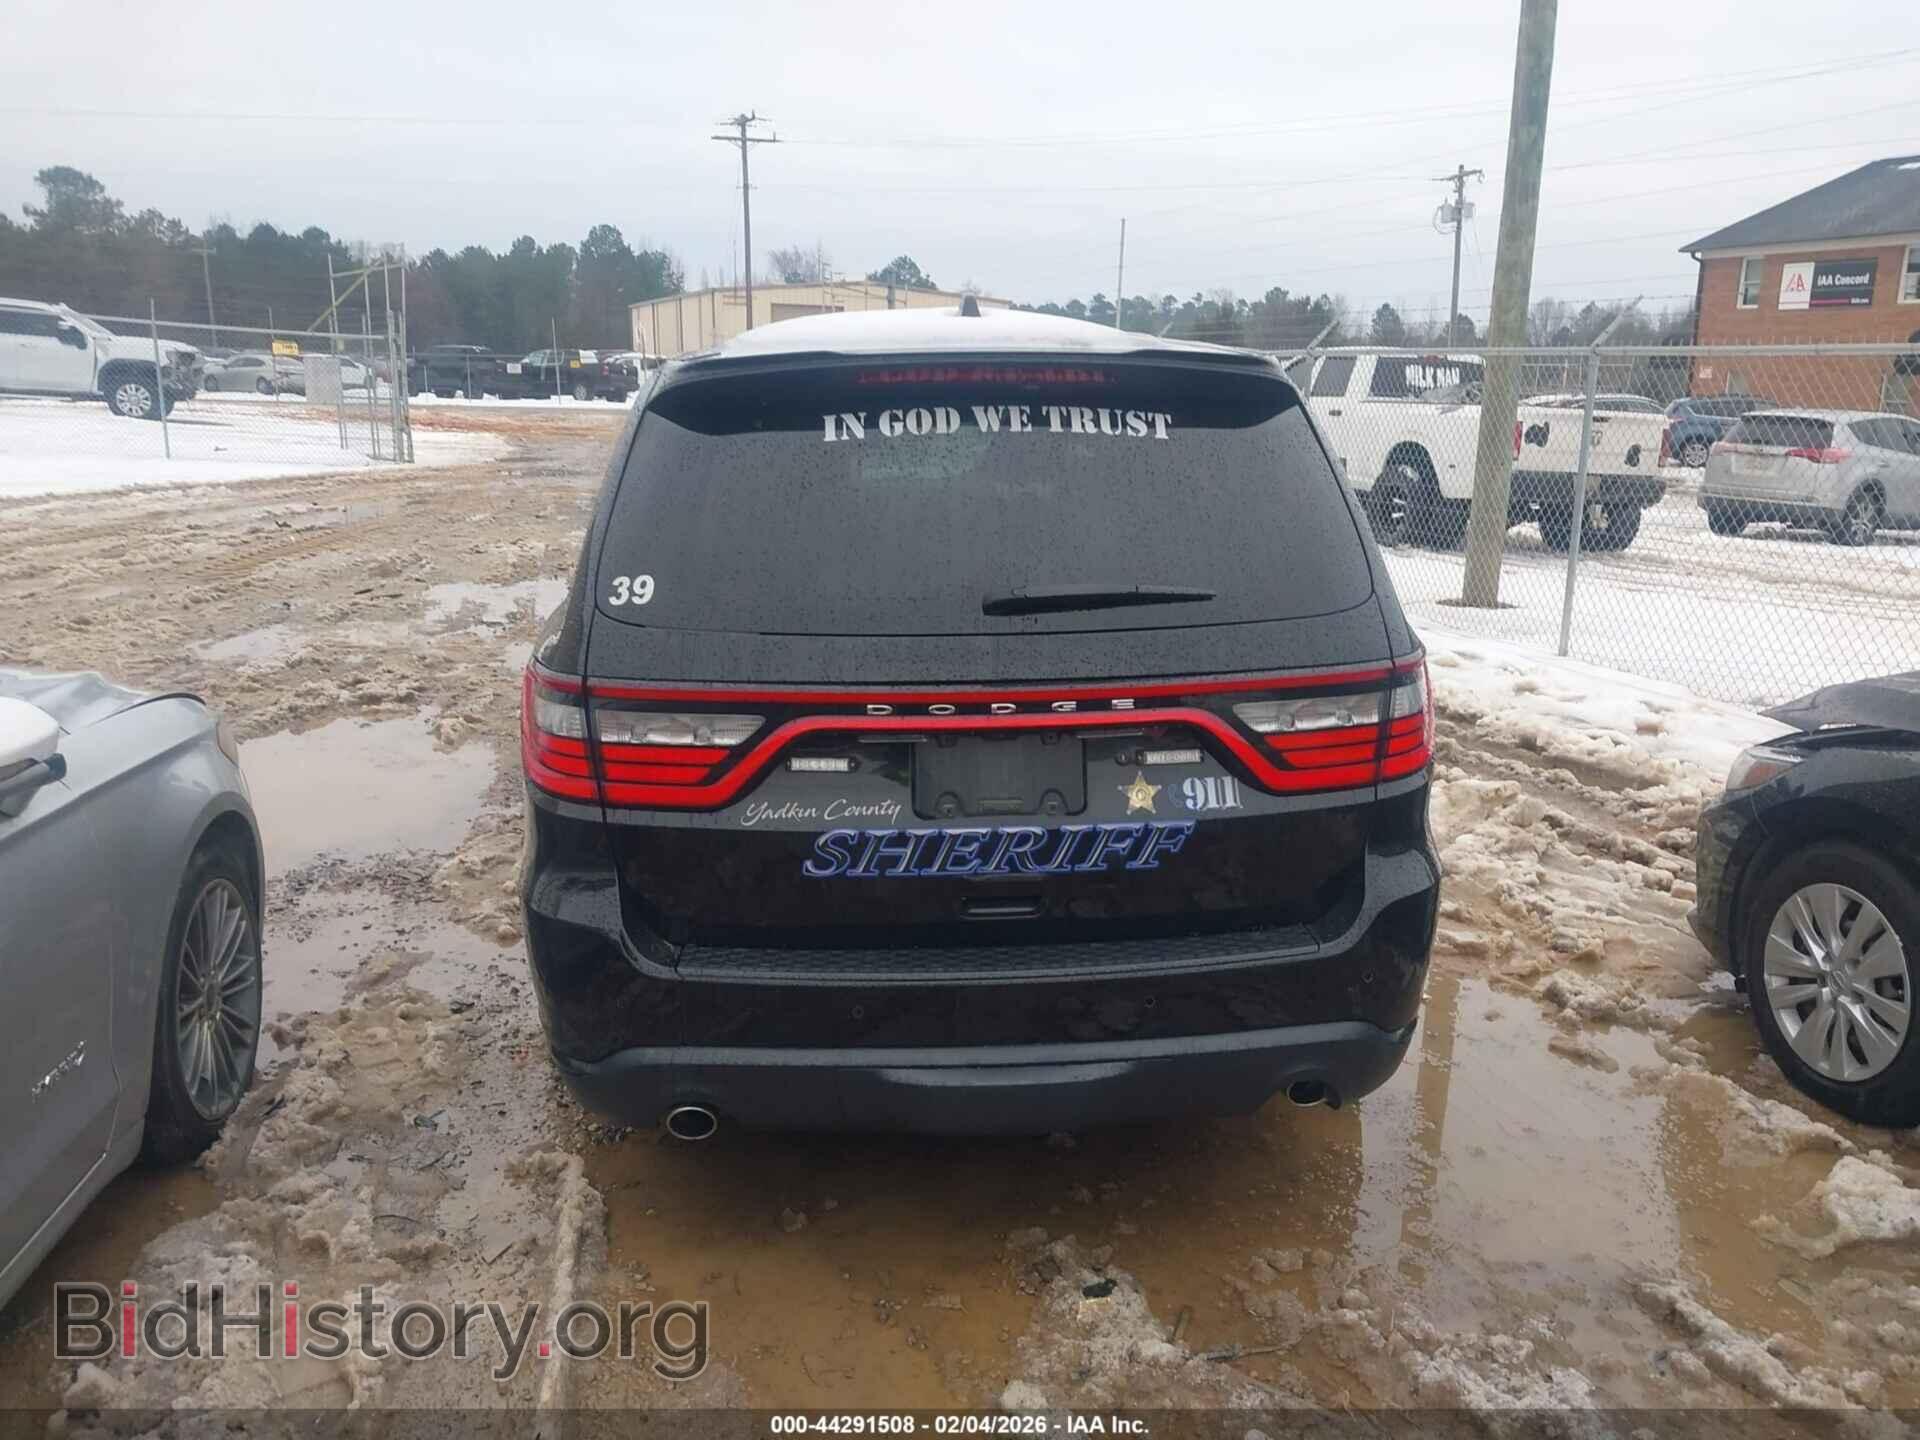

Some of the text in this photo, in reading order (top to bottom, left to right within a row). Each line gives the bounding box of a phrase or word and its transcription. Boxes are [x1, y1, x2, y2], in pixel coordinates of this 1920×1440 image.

[1817, 272, 1870, 286] IAA Concord
[1405, 364, 1460, 389] MILK MAN
[822, 405, 1172, 441] IN GOD WE TRUST
[608, 574, 655, 606] 39
[866, 698, 1135, 715] DODGE
[1182, 775, 1243, 811] 911
[740, 799, 902, 826] Yadkin County
[802, 820, 1196, 878] SHERIFF
